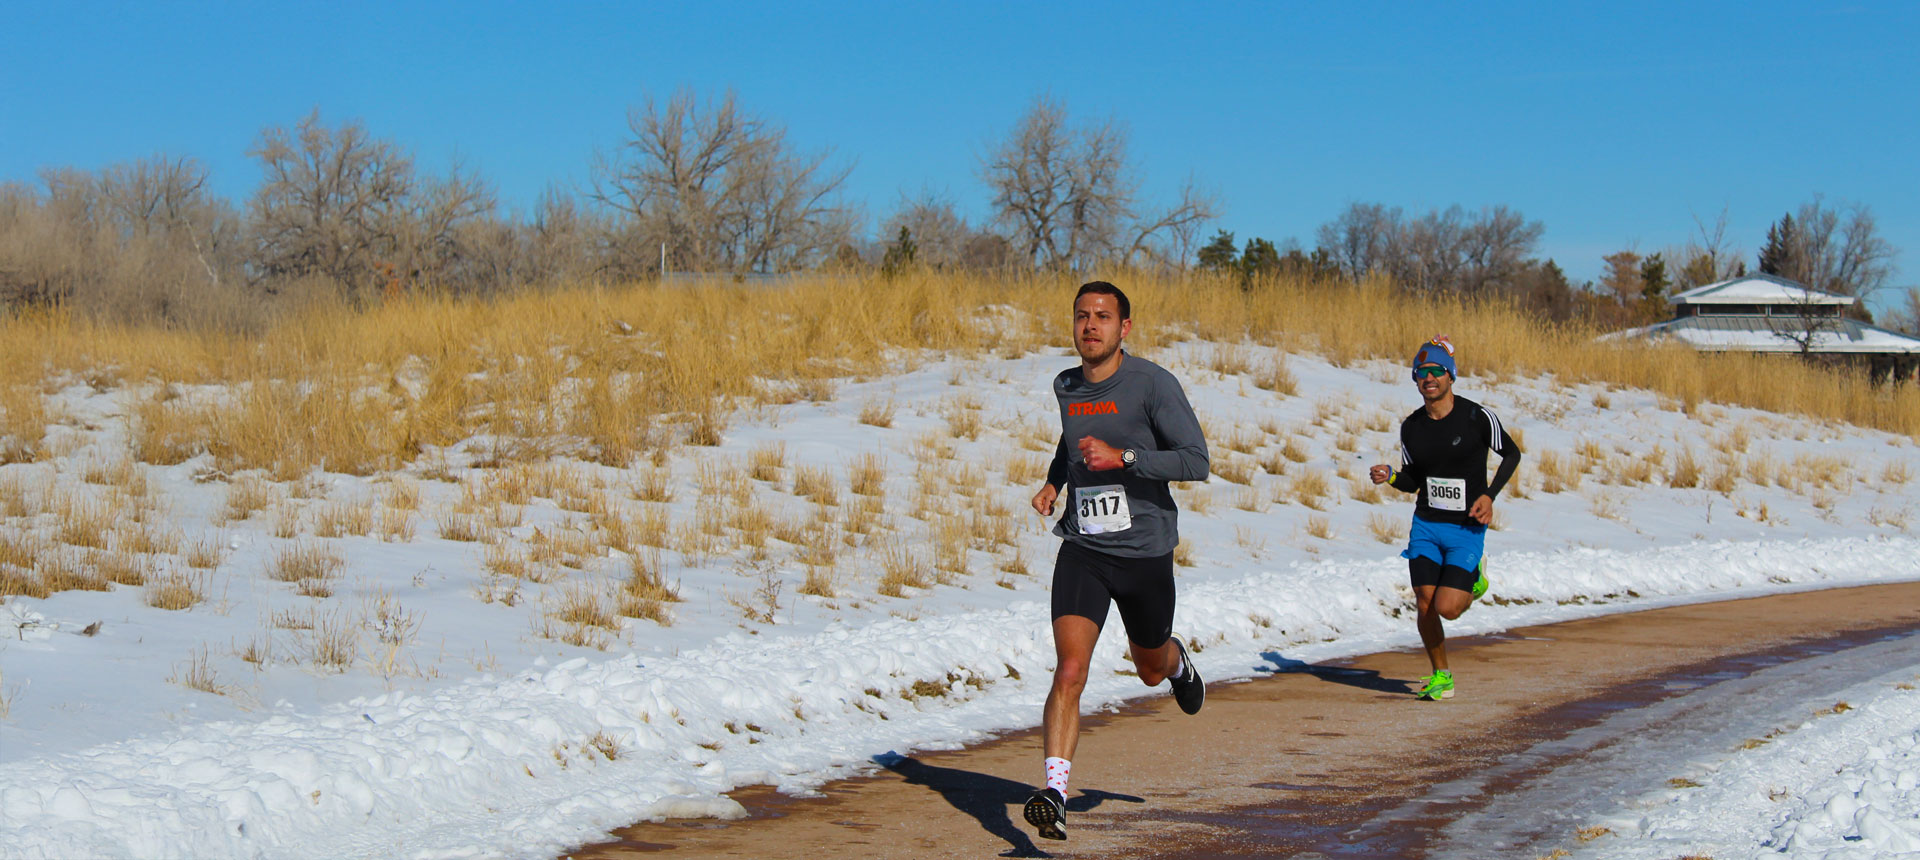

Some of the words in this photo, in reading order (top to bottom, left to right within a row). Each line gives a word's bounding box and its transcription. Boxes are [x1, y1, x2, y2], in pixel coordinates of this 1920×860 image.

[1068, 401, 1119, 416] STRAVA
[1431, 485, 1461, 500] 3056
[1081, 495, 1120, 518] 3117
